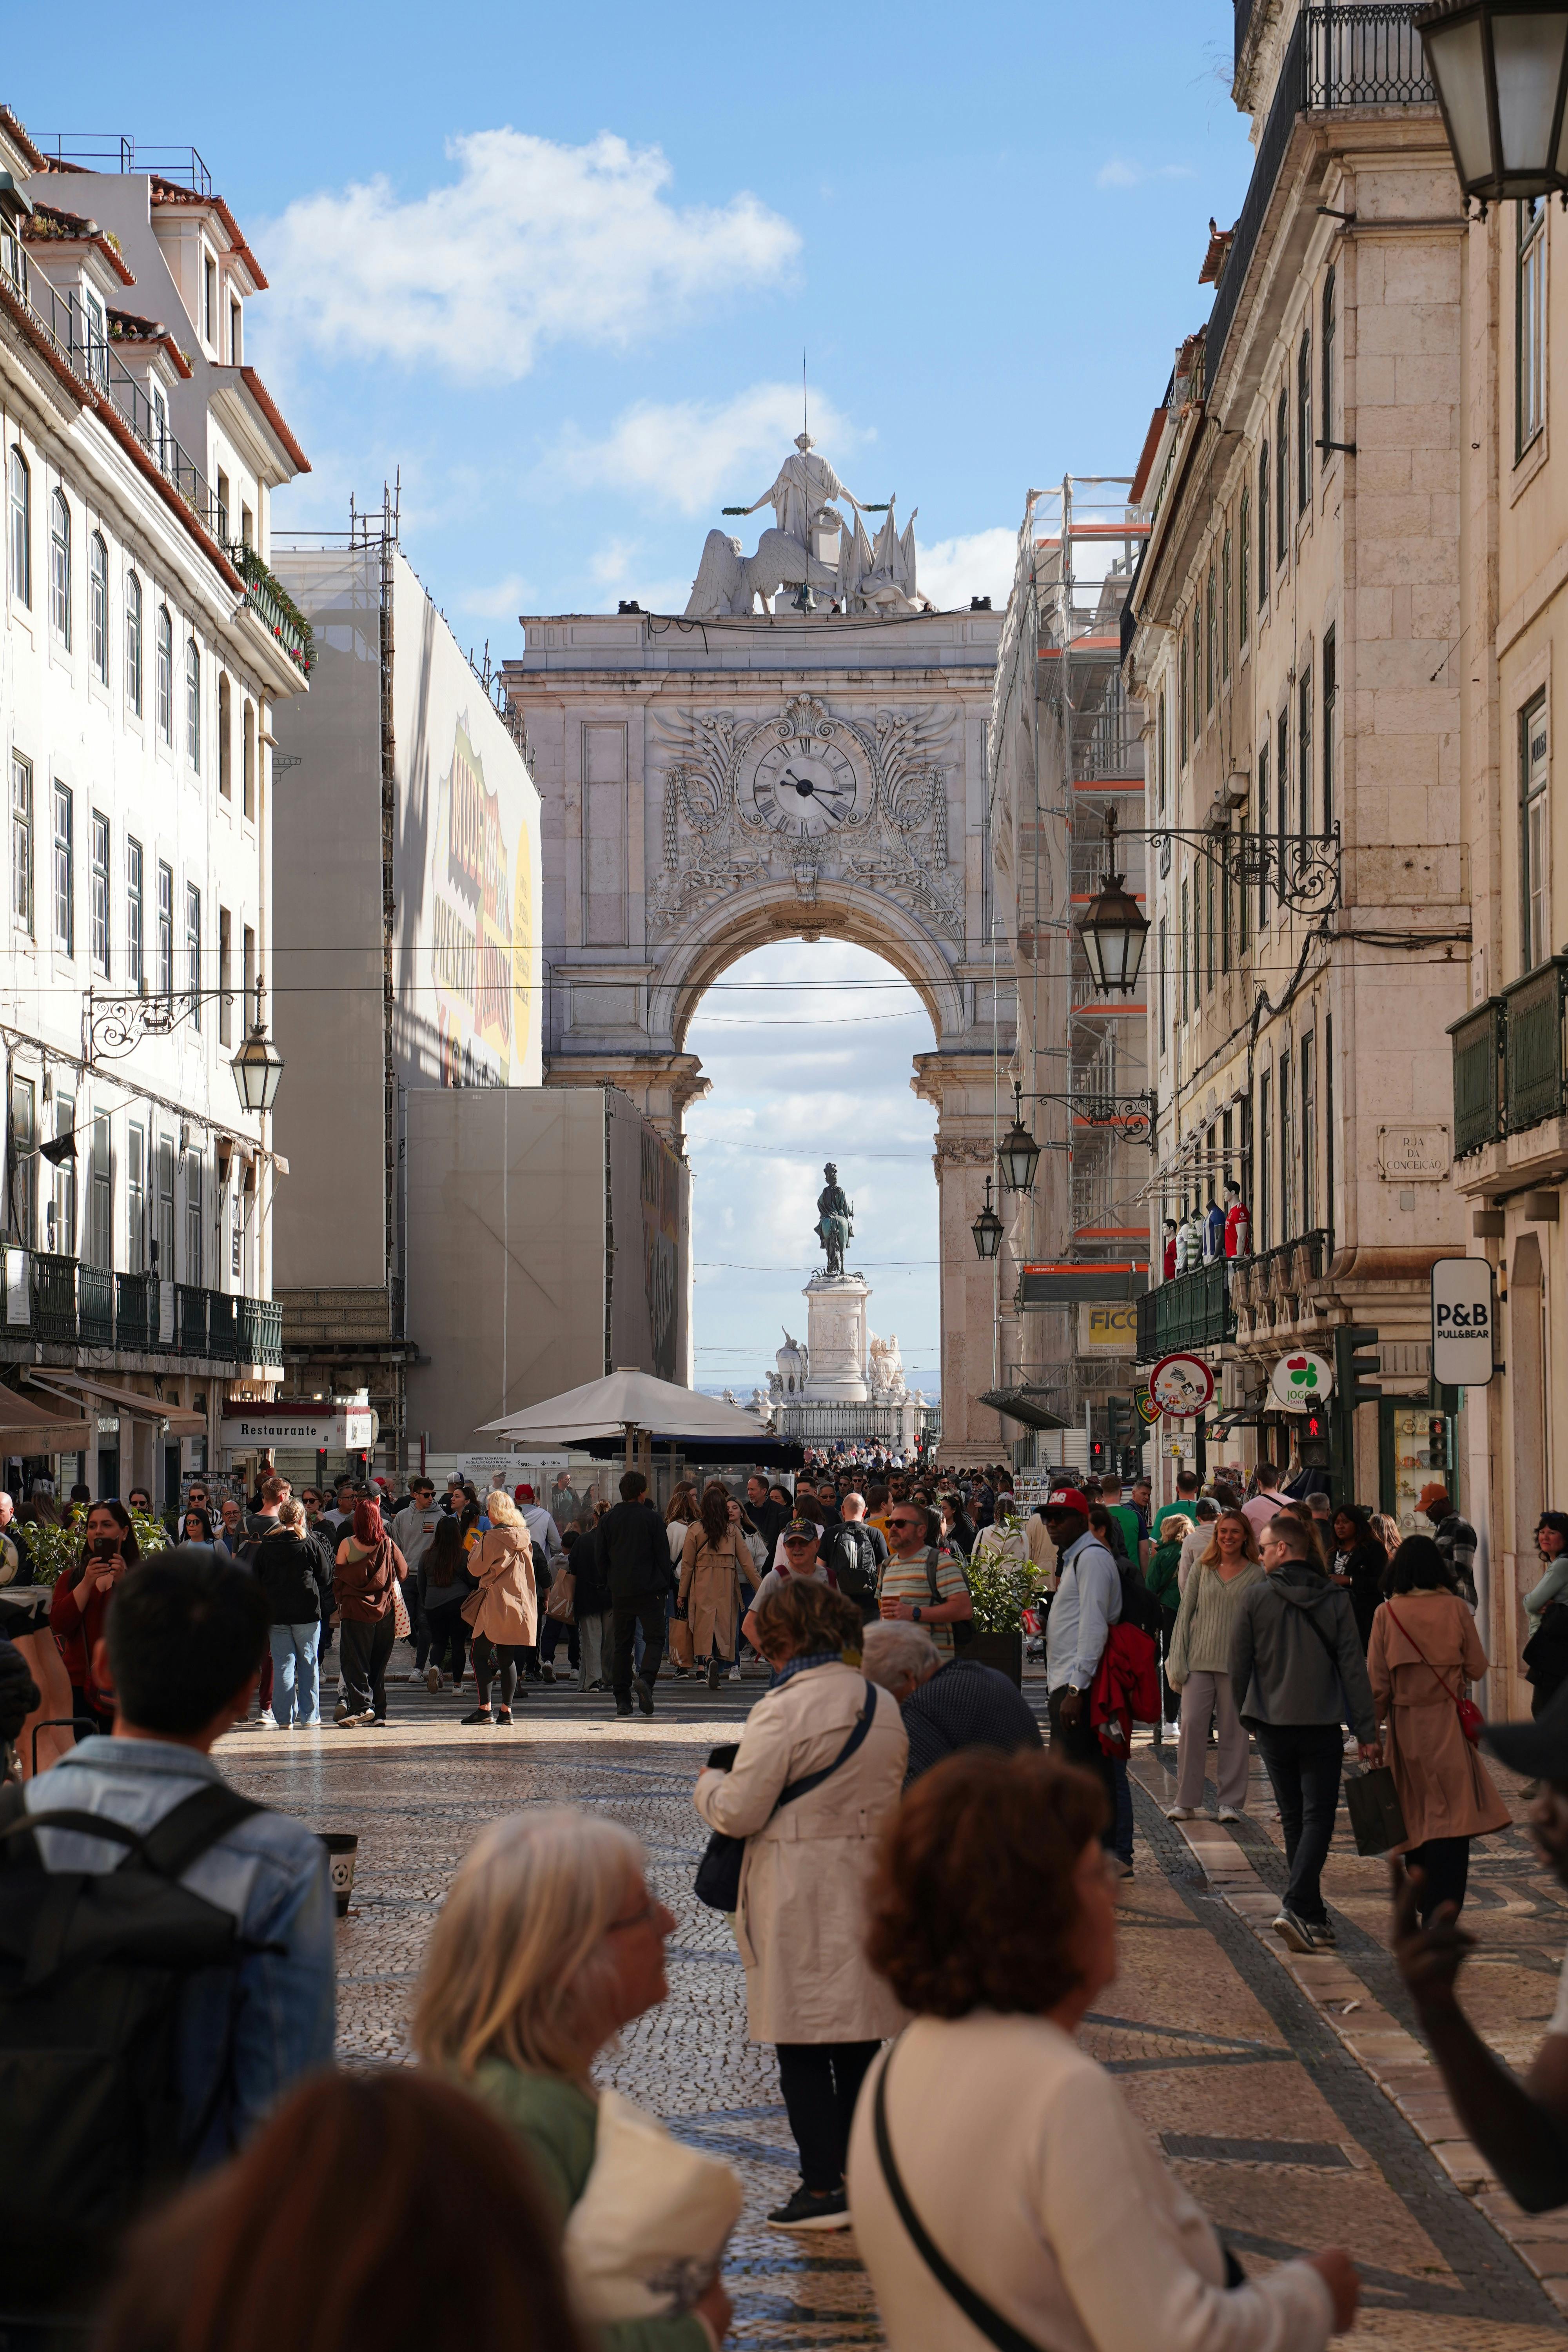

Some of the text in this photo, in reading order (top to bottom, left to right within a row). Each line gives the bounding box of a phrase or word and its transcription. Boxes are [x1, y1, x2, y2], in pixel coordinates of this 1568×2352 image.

[450, 746, 497, 888] MUDE no
[1403, 1138, 1424, 1146] RUA
[1408, 1149, 1420, 1157] DA
[1387, 1159, 1441, 1169] CONCEIÇÃO
[1437, 1303, 1488, 1327] P&B
[1437, 1330, 1488, 1338] PULL&BEAR
[1287, 1390, 1318, 1401] JOGO
[241, 1424, 316, 1435] Restaurante
